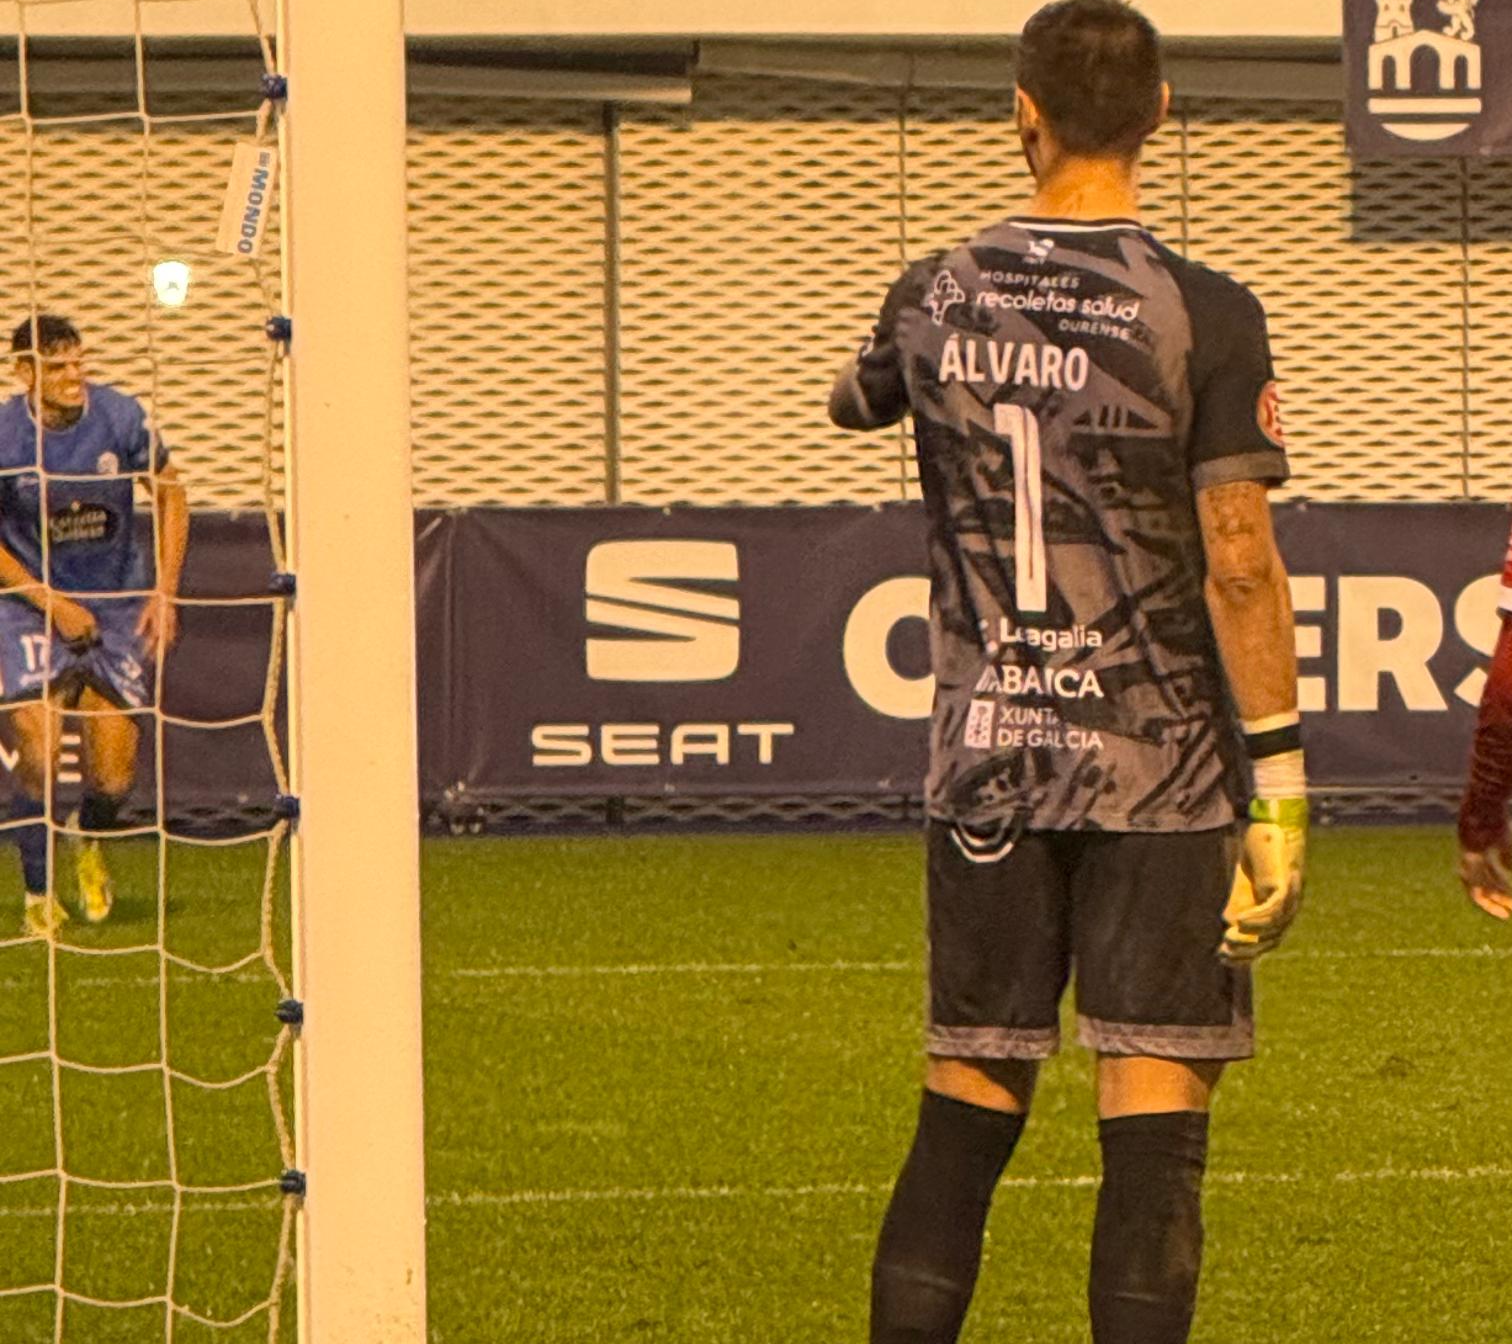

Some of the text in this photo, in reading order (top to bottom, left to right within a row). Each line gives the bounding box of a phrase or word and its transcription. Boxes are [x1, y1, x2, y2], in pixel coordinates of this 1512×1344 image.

[237, 167, 270, 254] MONDO
[979, 271, 1081, 290] HOSPITALES
[975, 290, 1141, 321] recoletas salud
[1058, 319, 1132, 341] OURENSE
[938, 333, 1090, 392] ÁLVARO
[993, 402, 1048, 613] 1
[531, 722, 795, 767] SEAT
